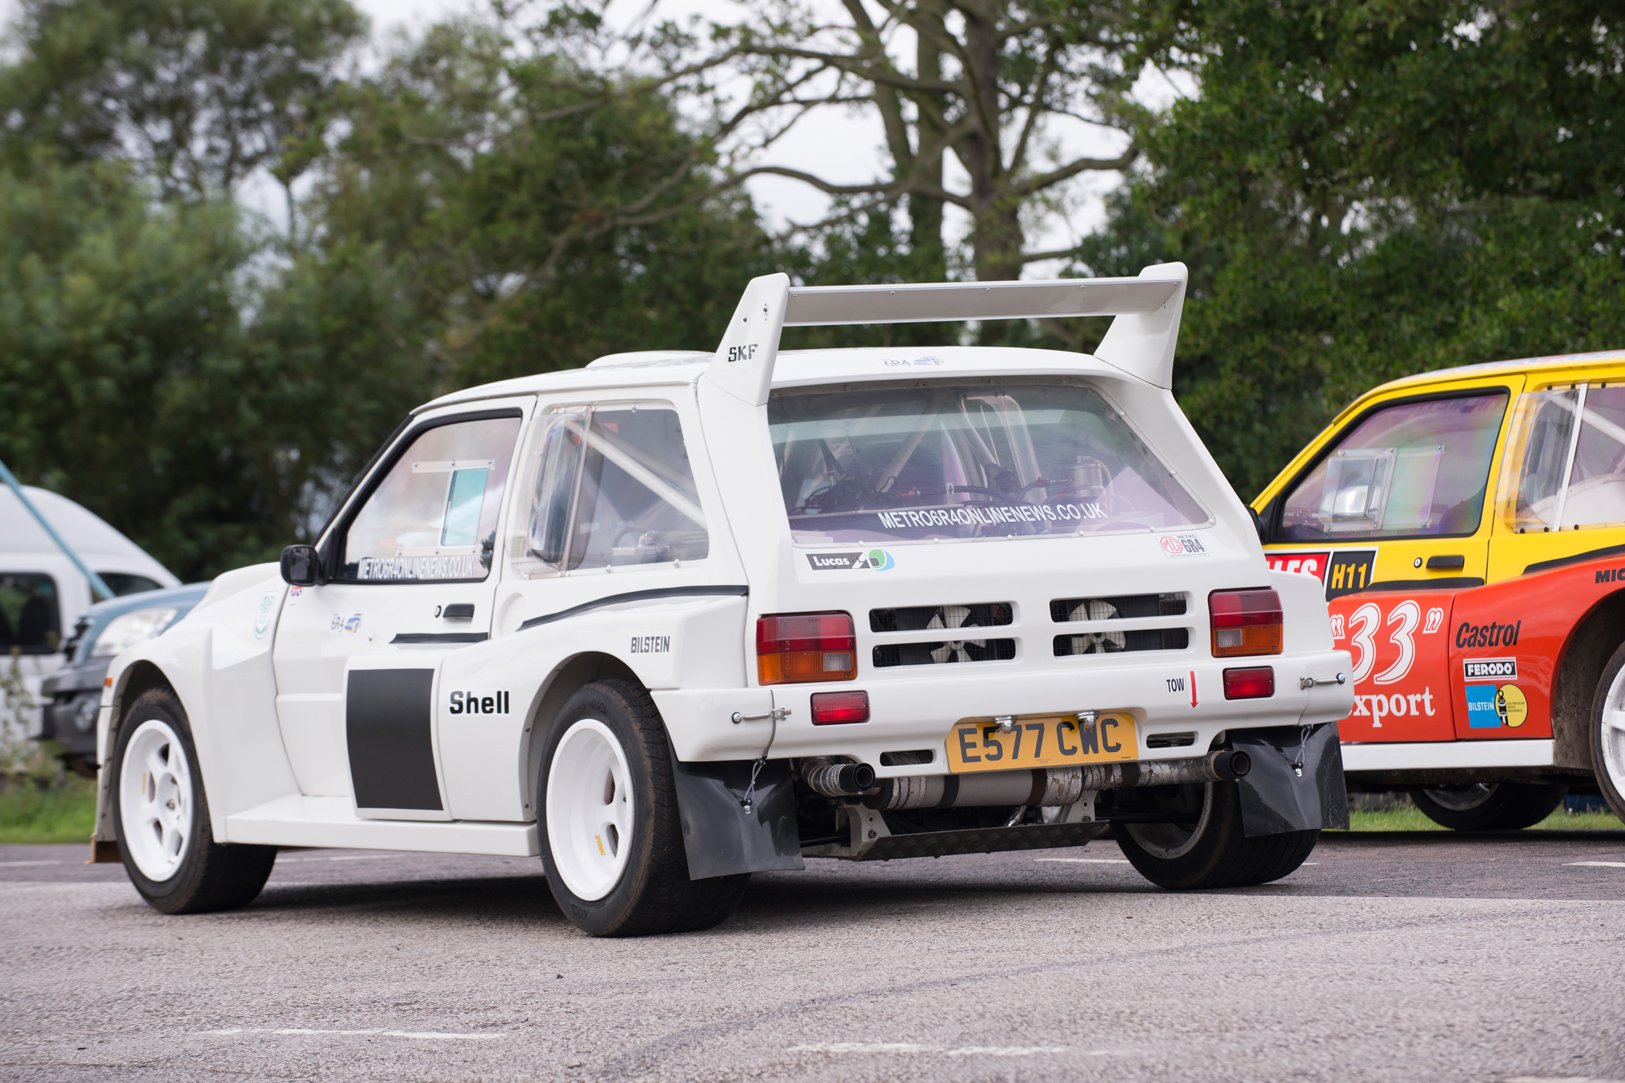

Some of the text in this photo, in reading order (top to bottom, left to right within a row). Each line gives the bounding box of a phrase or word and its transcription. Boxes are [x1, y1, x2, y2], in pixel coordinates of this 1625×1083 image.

[728, 344, 758, 362] SKF
[878, 503, 1108, 528] METRO6R4ONLINENEWS.CO.UK
[1162, 537, 1182, 553] MG
[1181, 538, 1206, 553] 6R4
[812, 556, 850, 567] Lucas
[1331, 563, 1368, 589] H11
[1455, 620, 1521, 648] Castrol
[630, 636, 670, 653] BILSTEIN
[1467, 662, 1513, 676] FERODO
[1166, 678, 1185, 692] TOW
[449, 690, 510, 714] Shell
[1468, 701, 1495, 711] BILSTEIN
[957, 717, 1122, 763] E577 CWC
